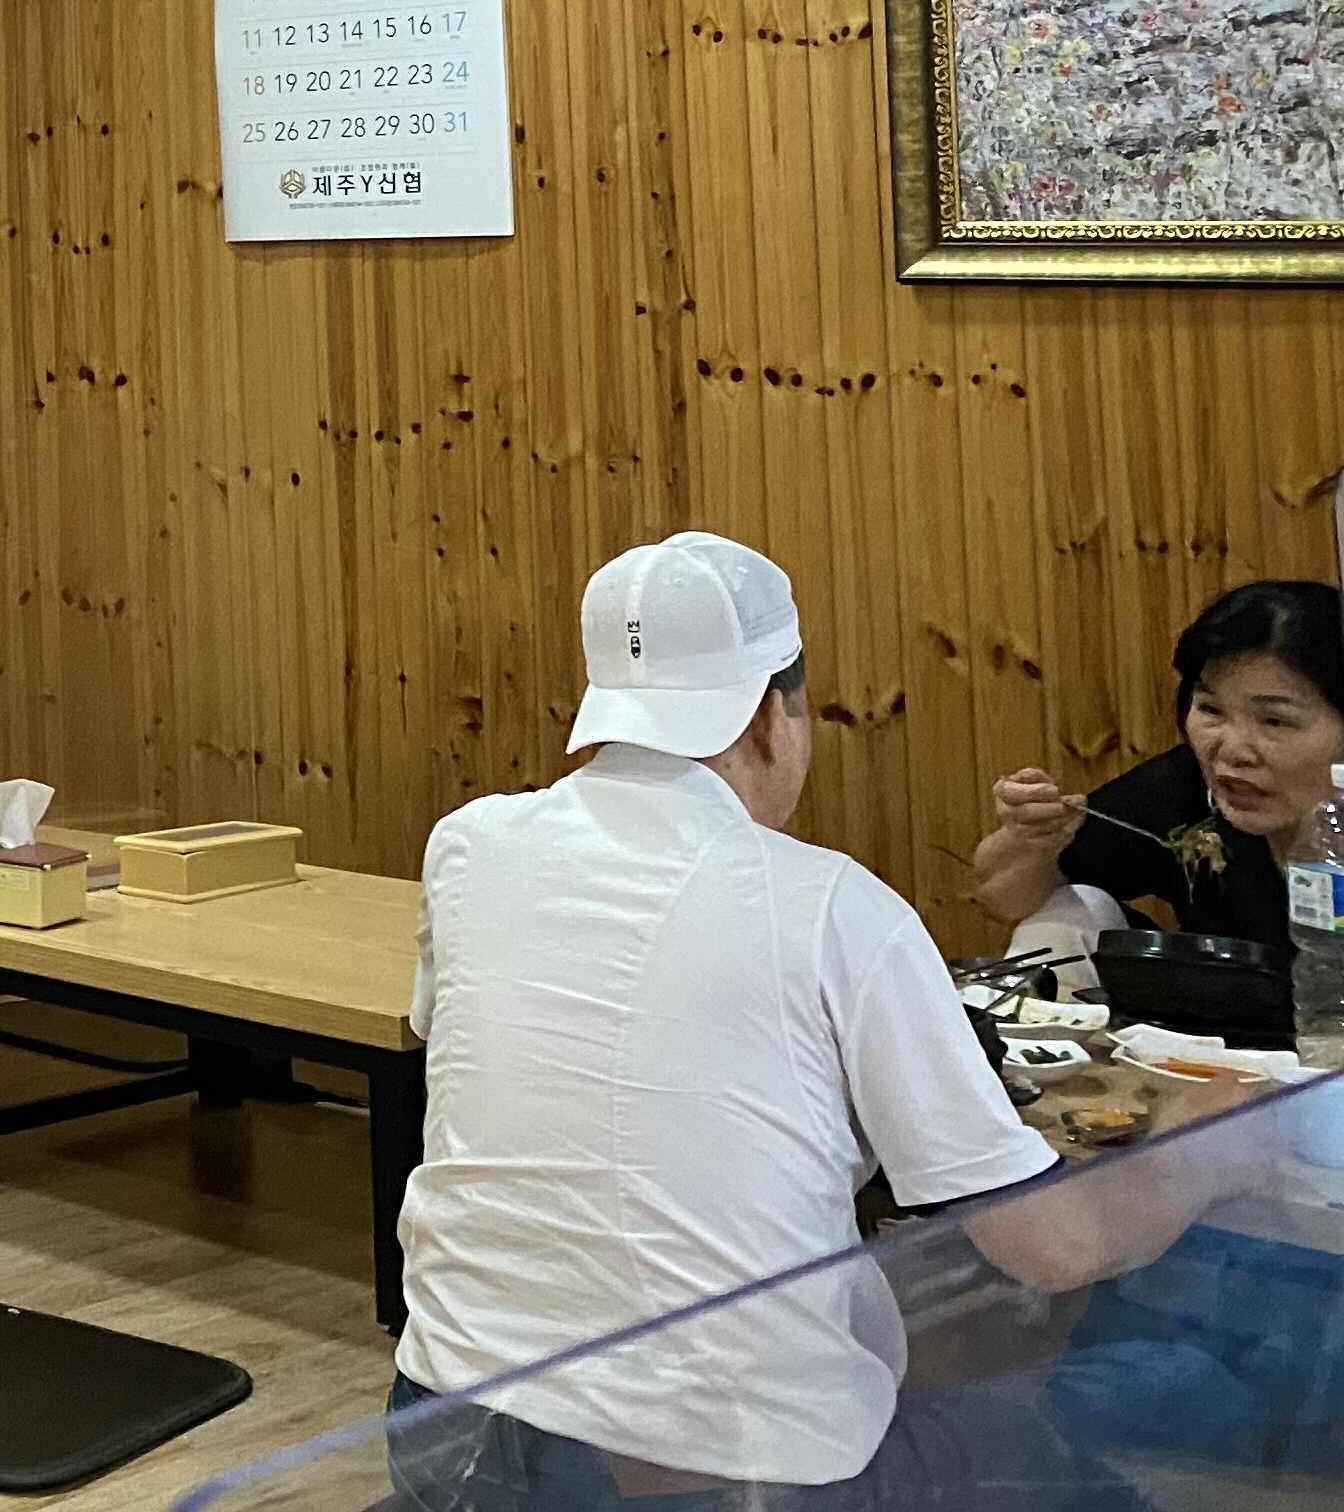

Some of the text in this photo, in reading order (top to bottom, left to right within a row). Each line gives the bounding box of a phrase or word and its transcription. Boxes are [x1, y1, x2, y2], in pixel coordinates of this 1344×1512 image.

[242, 11, 466, 49] 11 12 13 14 15 16 17
[243, 61, 469, 96] 18 19 20 21 22 23 24
[243, 112, 467, 143] 25 26 27 28 29 30 31
[312, 172, 421, 196] 제주Y신협
